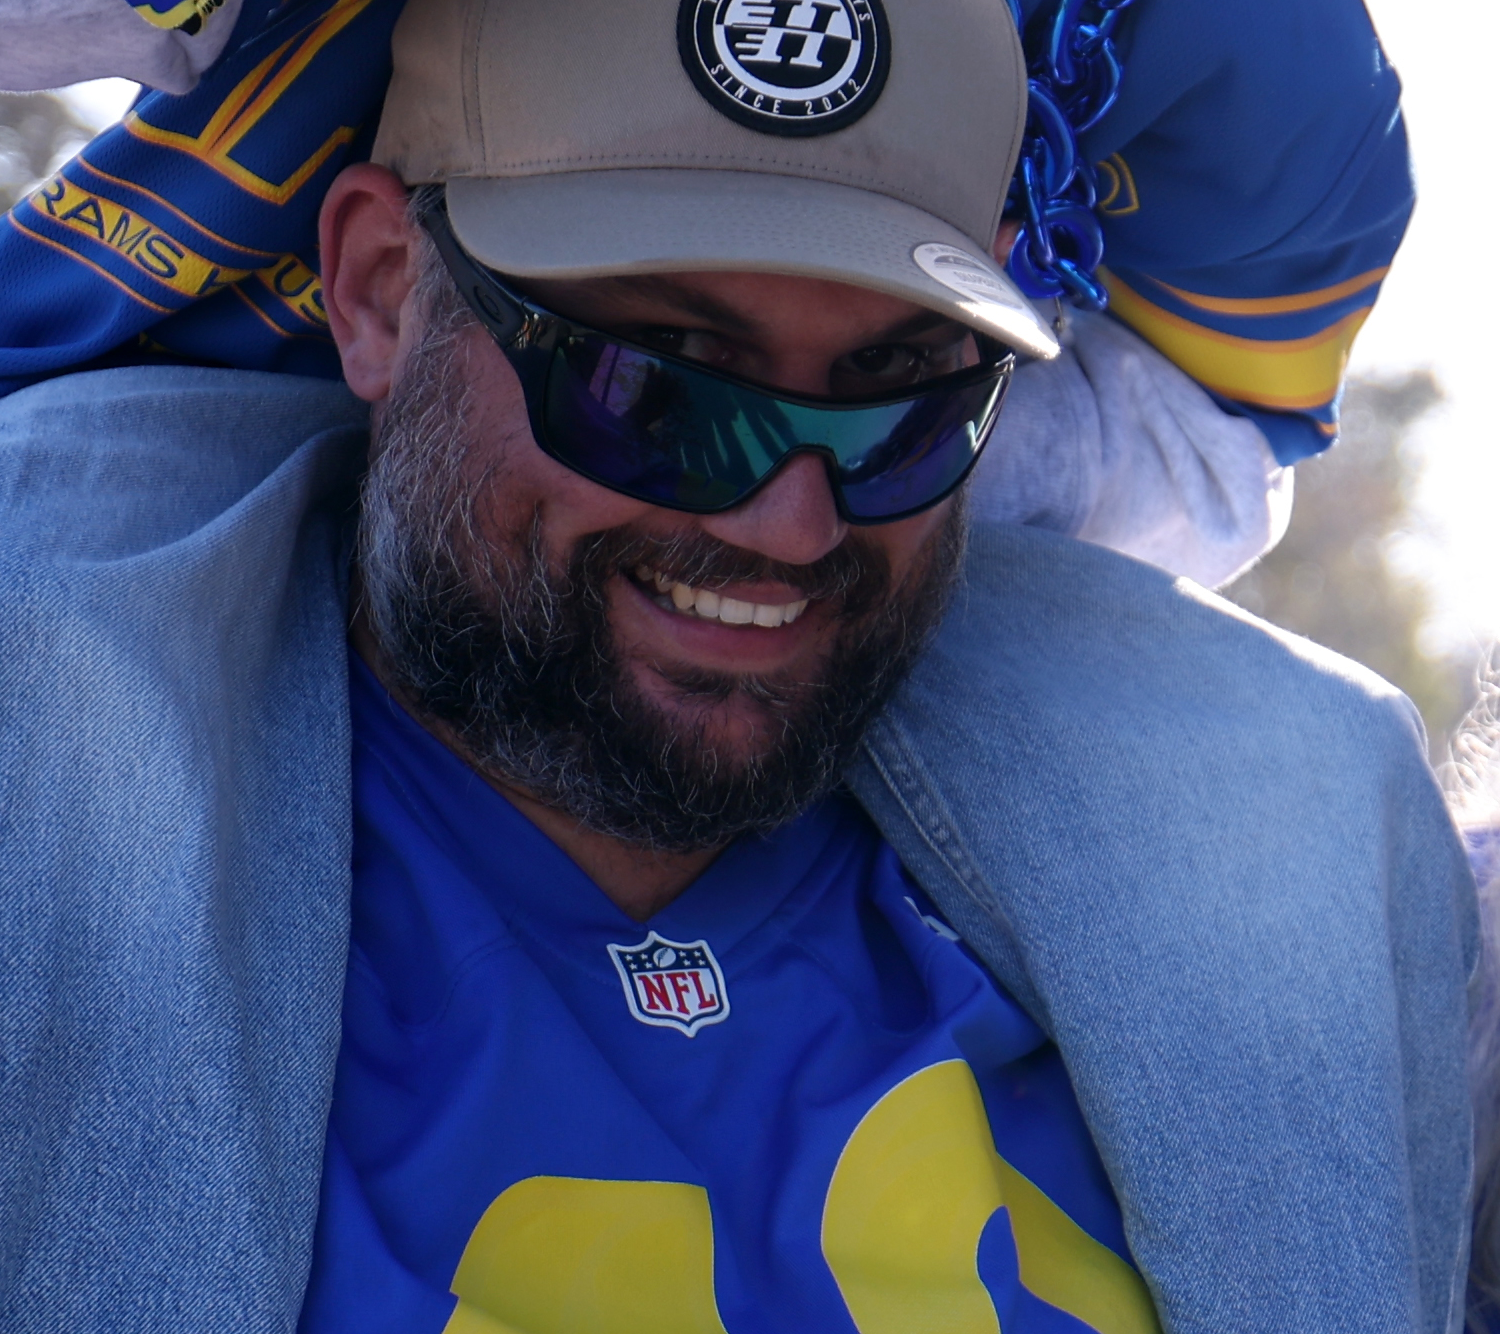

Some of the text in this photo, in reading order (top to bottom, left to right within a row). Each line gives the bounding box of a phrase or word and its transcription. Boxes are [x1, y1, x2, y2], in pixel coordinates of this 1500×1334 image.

[711, 63, 860, 115] SINCE 2012
[35, 178, 187, 280] RAMS
[637, 970, 717, 1015] NFL
